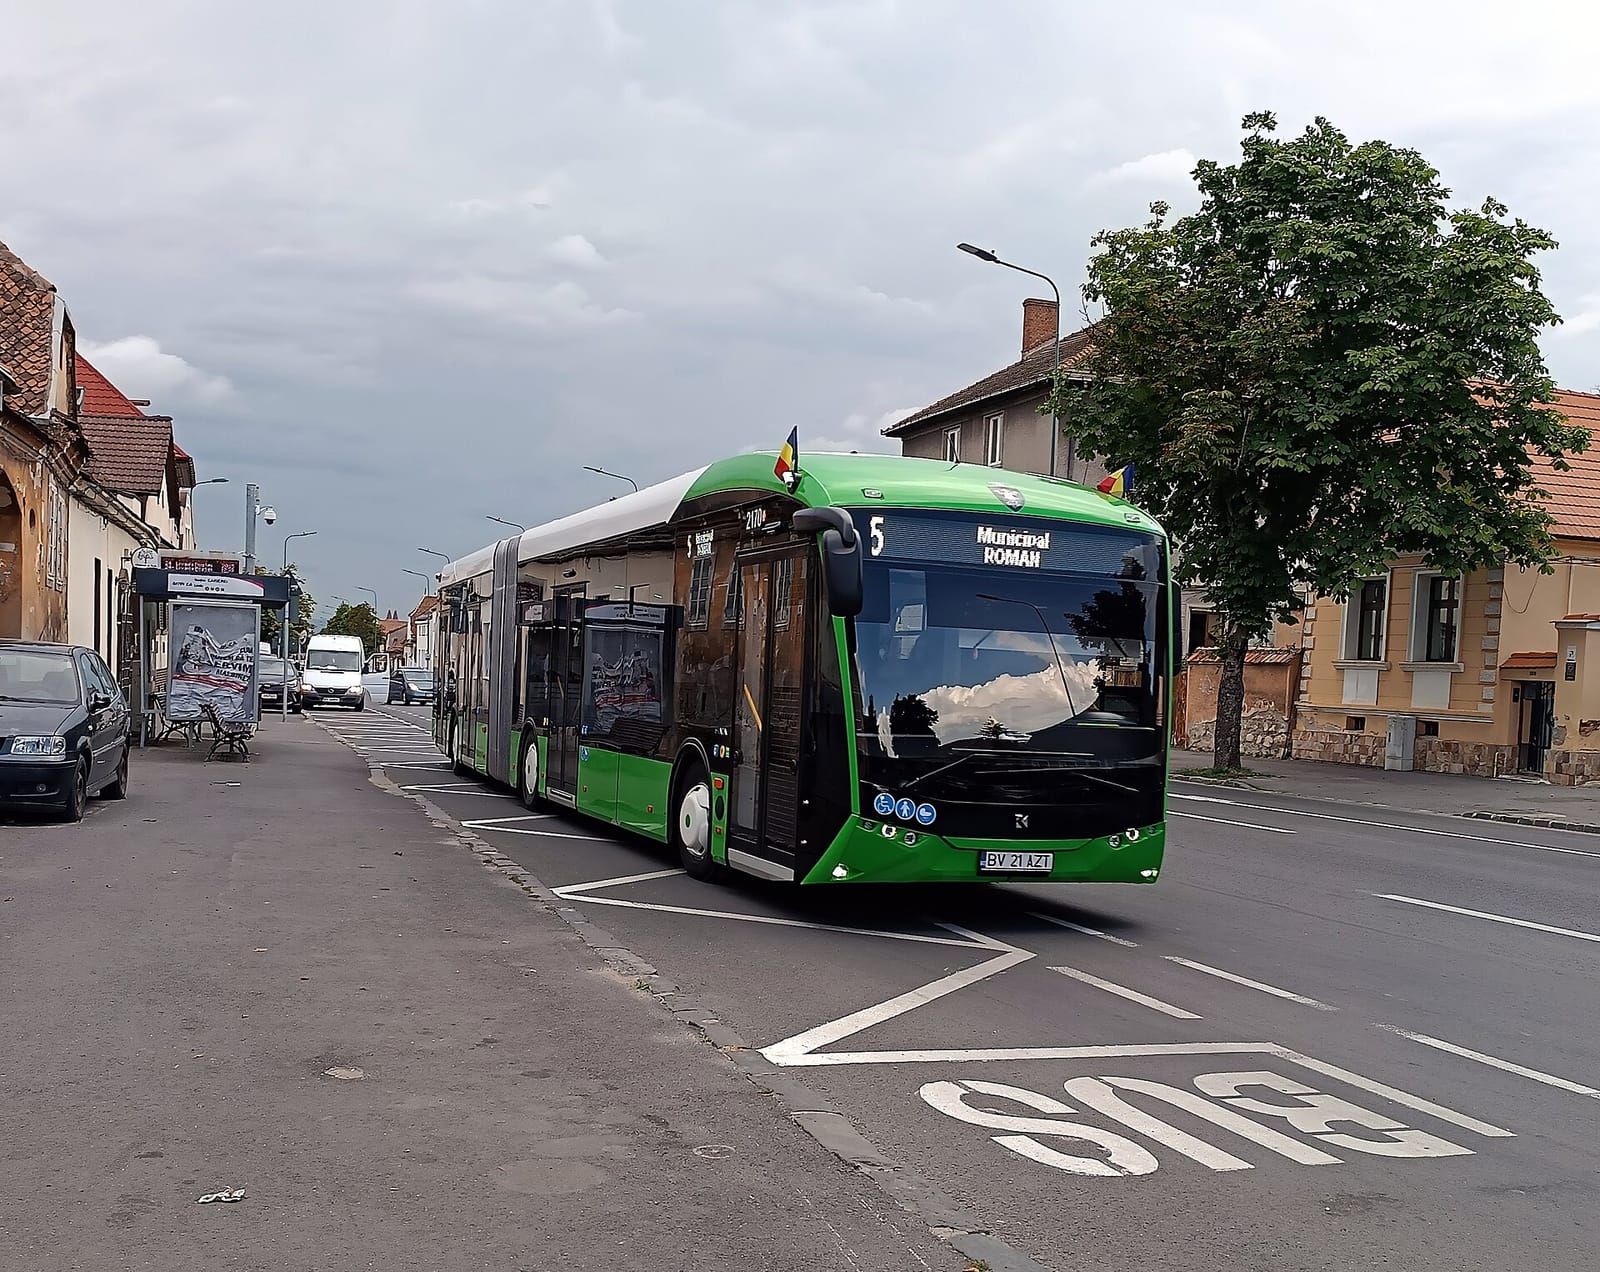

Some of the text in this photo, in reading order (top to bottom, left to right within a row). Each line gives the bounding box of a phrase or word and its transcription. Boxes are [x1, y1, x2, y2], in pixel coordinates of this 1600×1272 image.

[869, 515, 885, 557] 5
[976, 526, 1051, 550] Municipal
[983, 546, 1041, 568] ROMAN
[987, 853, 1006, 867] BV
[1010, 854, 1023, 867] 21
[1026, 854, 1051, 868] AZT
[919, 1070, 1477, 1177] BUS
